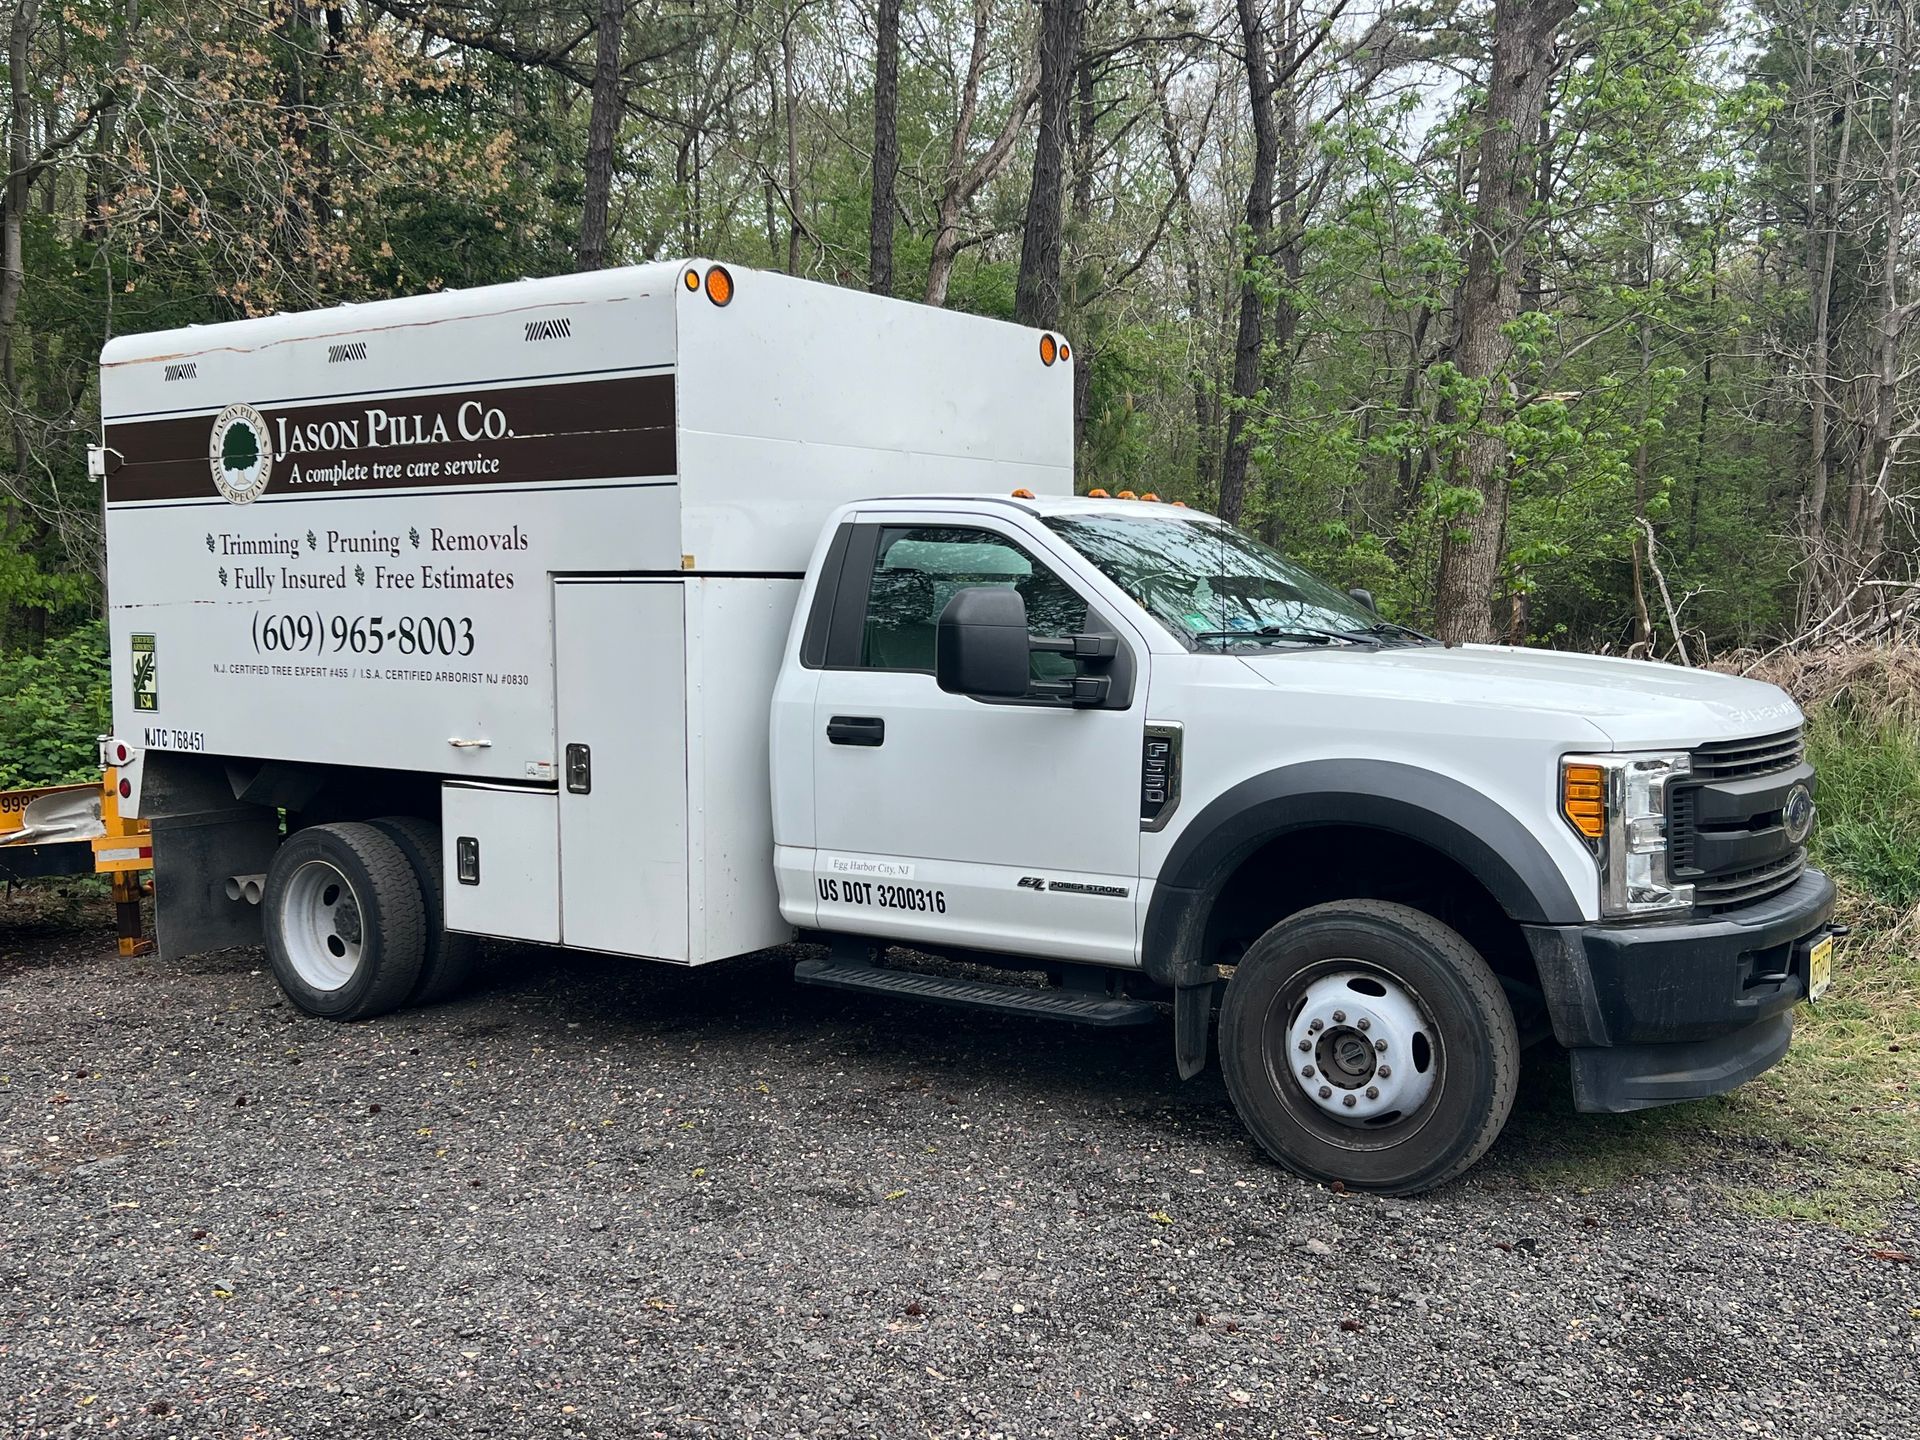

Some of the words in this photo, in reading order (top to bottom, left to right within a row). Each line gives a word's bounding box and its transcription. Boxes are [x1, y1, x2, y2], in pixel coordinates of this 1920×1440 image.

[214, 407, 238, 437] JASON
[240, 406, 264, 437] PILLA
[275, 417, 359, 462] JASON
[364, 409, 450, 448] PILLA
[228, 455, 270, 502] SPECIALIST
[289, 463, 303, 484] A
[305, 460, 368, 486] complete
[372, 463, 402, 479] tree
[406, 459, 440, 477] care
[444, 453, 500, 476] service
[218, 532, 300, 559] Trimming
[327, 529, 401, 558] Pruning
[430, 524, 529, 551] Removals
[234, 565, 276, 594] Fully
[280, 565, 347, 589] Insured
[375, 565, 415, 589] Free
[420, 565, 515, 589] Estimates
[213, 663, 228, 674] N.J.
[229, 664, 270, 675] CERTIFIED
[271, 665, 292, 676] TREE
[294, 666, 327, 677] EXPERT
[329, 668, 349, 678] #455
[360, 669, 383, 679] I.S.A.
[385, 669, 433, 682] CERTIFIED
[435, 671, 484, 683] ARBORIST
[486, 673, 498, 684] NJ
[501, 674, 529, 686] #0830
[140, 693, 153, 709] ISA
[144, 727, 168, 747] NJTC
[171, 729, 205, 751] 768451
[833, 859, 848, 871] Egg
[850, 860, 877, 872] Harbor
[877, 863, 896, 876] City,
[897, 864, 910, 875] NJ
[818, 878, 839, 902] US
[842, 880, 872, 905] DOT
[877, 884, 946, 914] 3200316
[1050, 881, 1084, 890] POWER
[1086, 884, 1126, 894] STROKE
